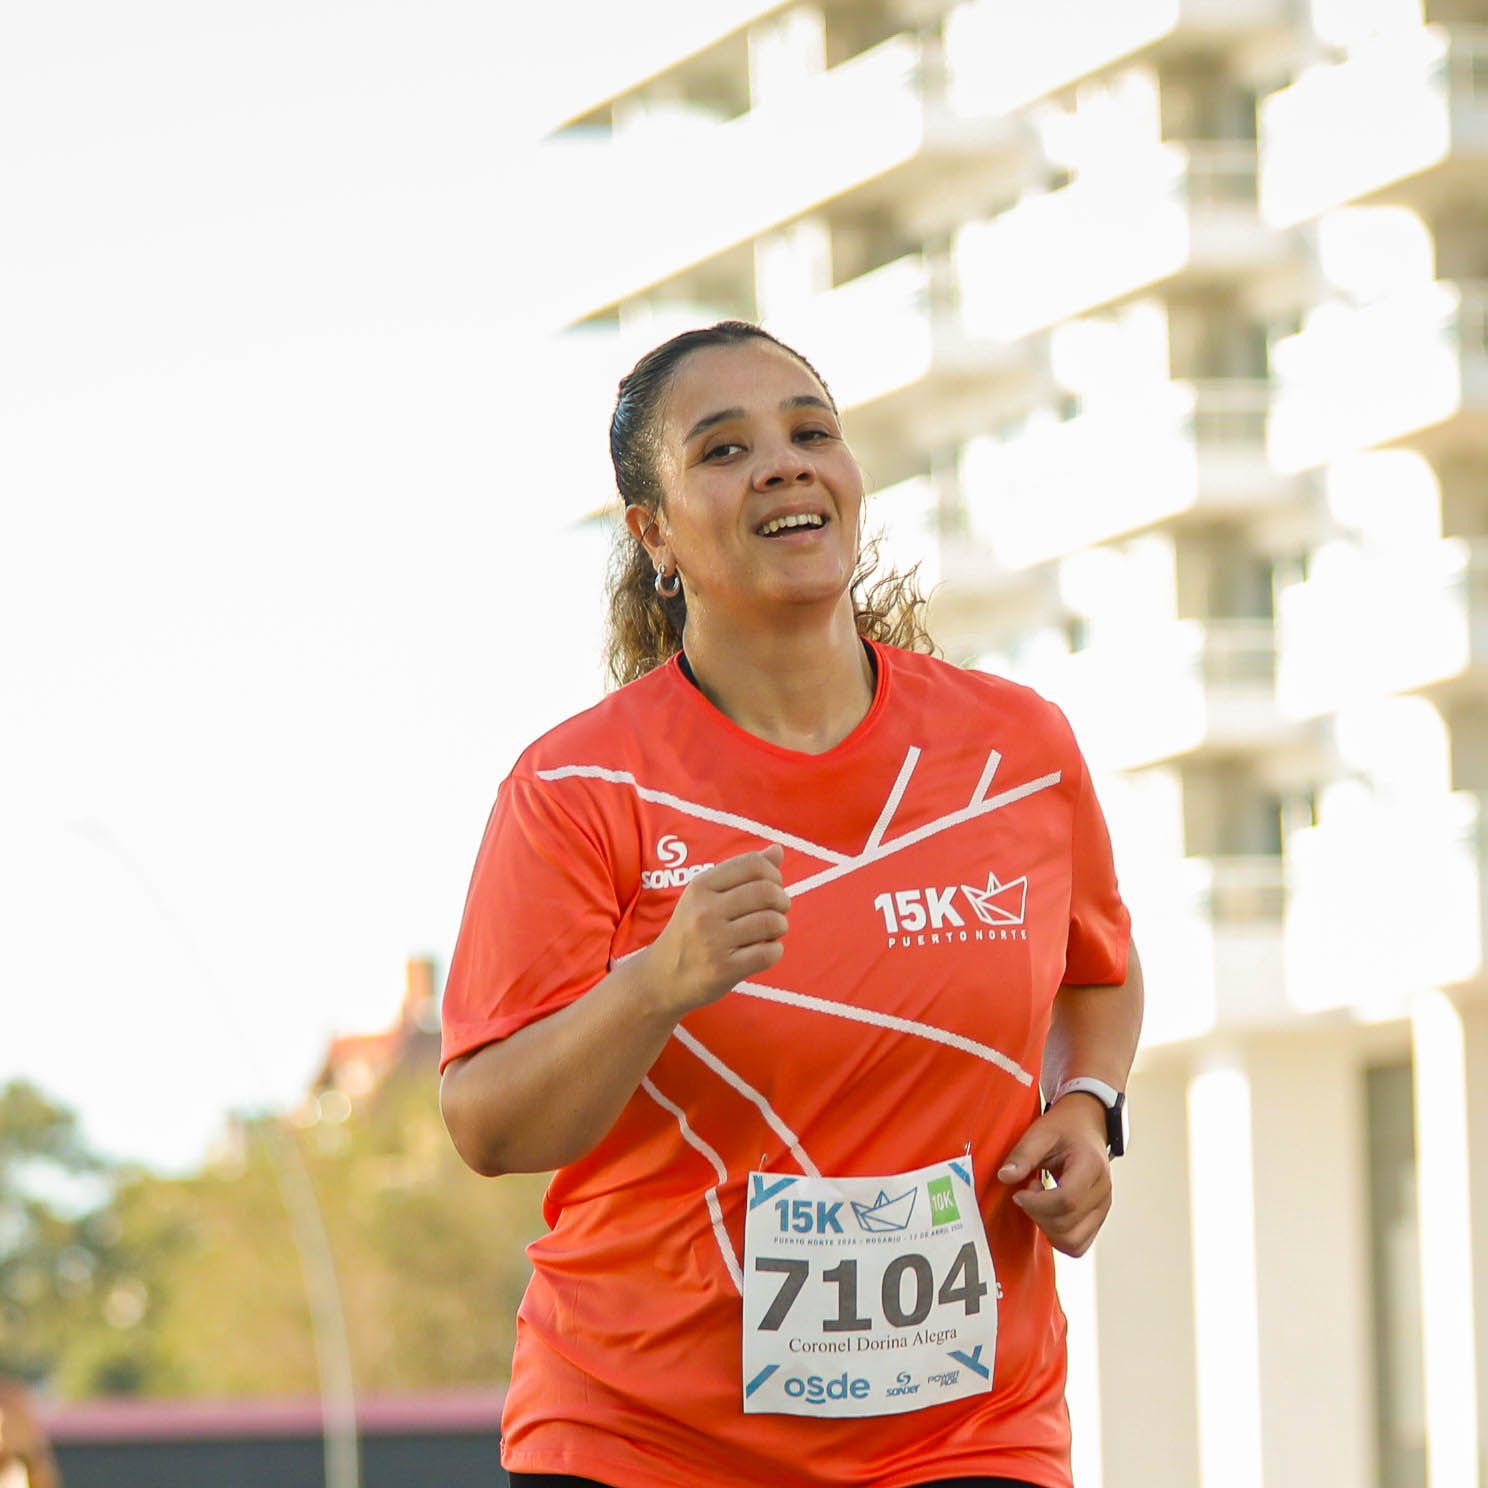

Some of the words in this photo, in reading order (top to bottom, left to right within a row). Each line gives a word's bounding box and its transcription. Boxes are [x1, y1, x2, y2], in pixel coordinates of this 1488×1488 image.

[874, 886, 965, 934] 15K
[888, 930, 968, 948] PUERTO
[975, 929, 1028, 941] NORTE
[774, 1199, 845, 1234] 15K
[932, 1191, 954, 1212] 10K
[755, 1239, 988, 1333] 7104
[788, 1337, 852, 1353] Coronel
[857, 1335, 908, 1351] Dorina
[912, 1327, 958, 1347] Alegra
[784, 1371, 870, 1402] osde
